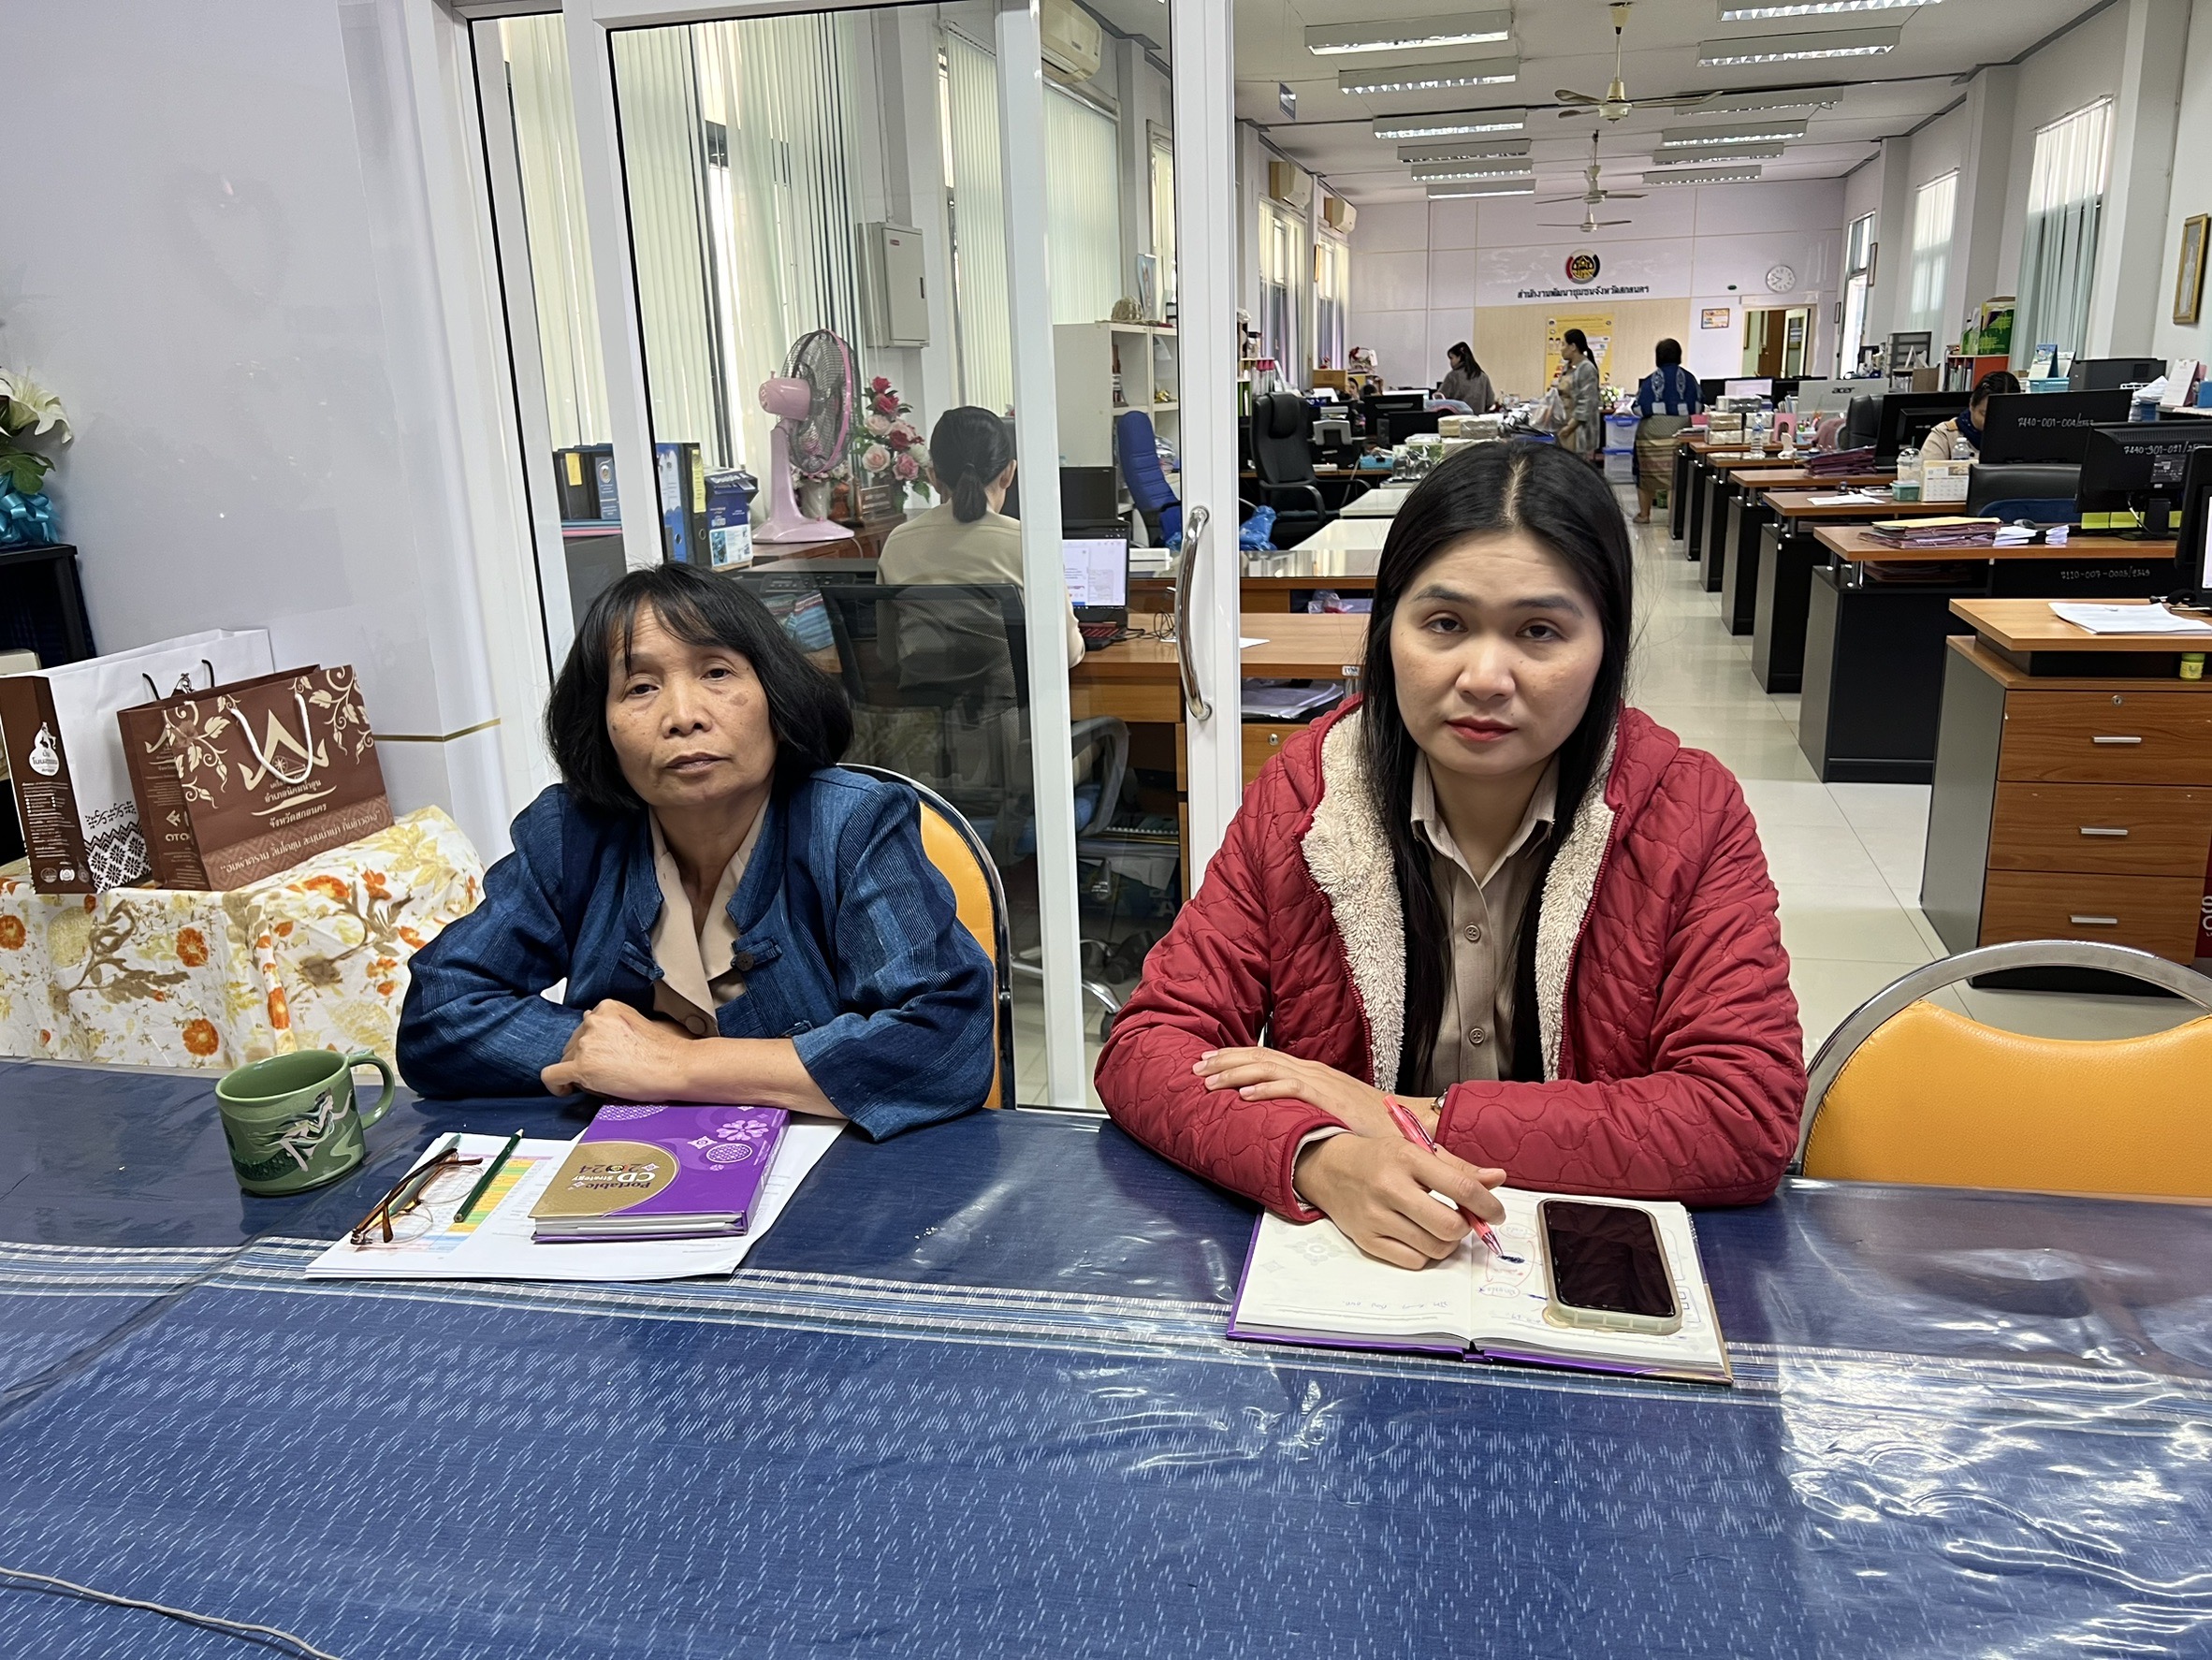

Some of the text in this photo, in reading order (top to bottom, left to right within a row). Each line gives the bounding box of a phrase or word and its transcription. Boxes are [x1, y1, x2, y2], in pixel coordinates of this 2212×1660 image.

[269, 803, 327, 828] จังหวัดสกลนคร
[165, 832, 191, 841] OTO
[616, 1172, 656, 1183] CD
[585, 1181, 651, 1190] Portable
